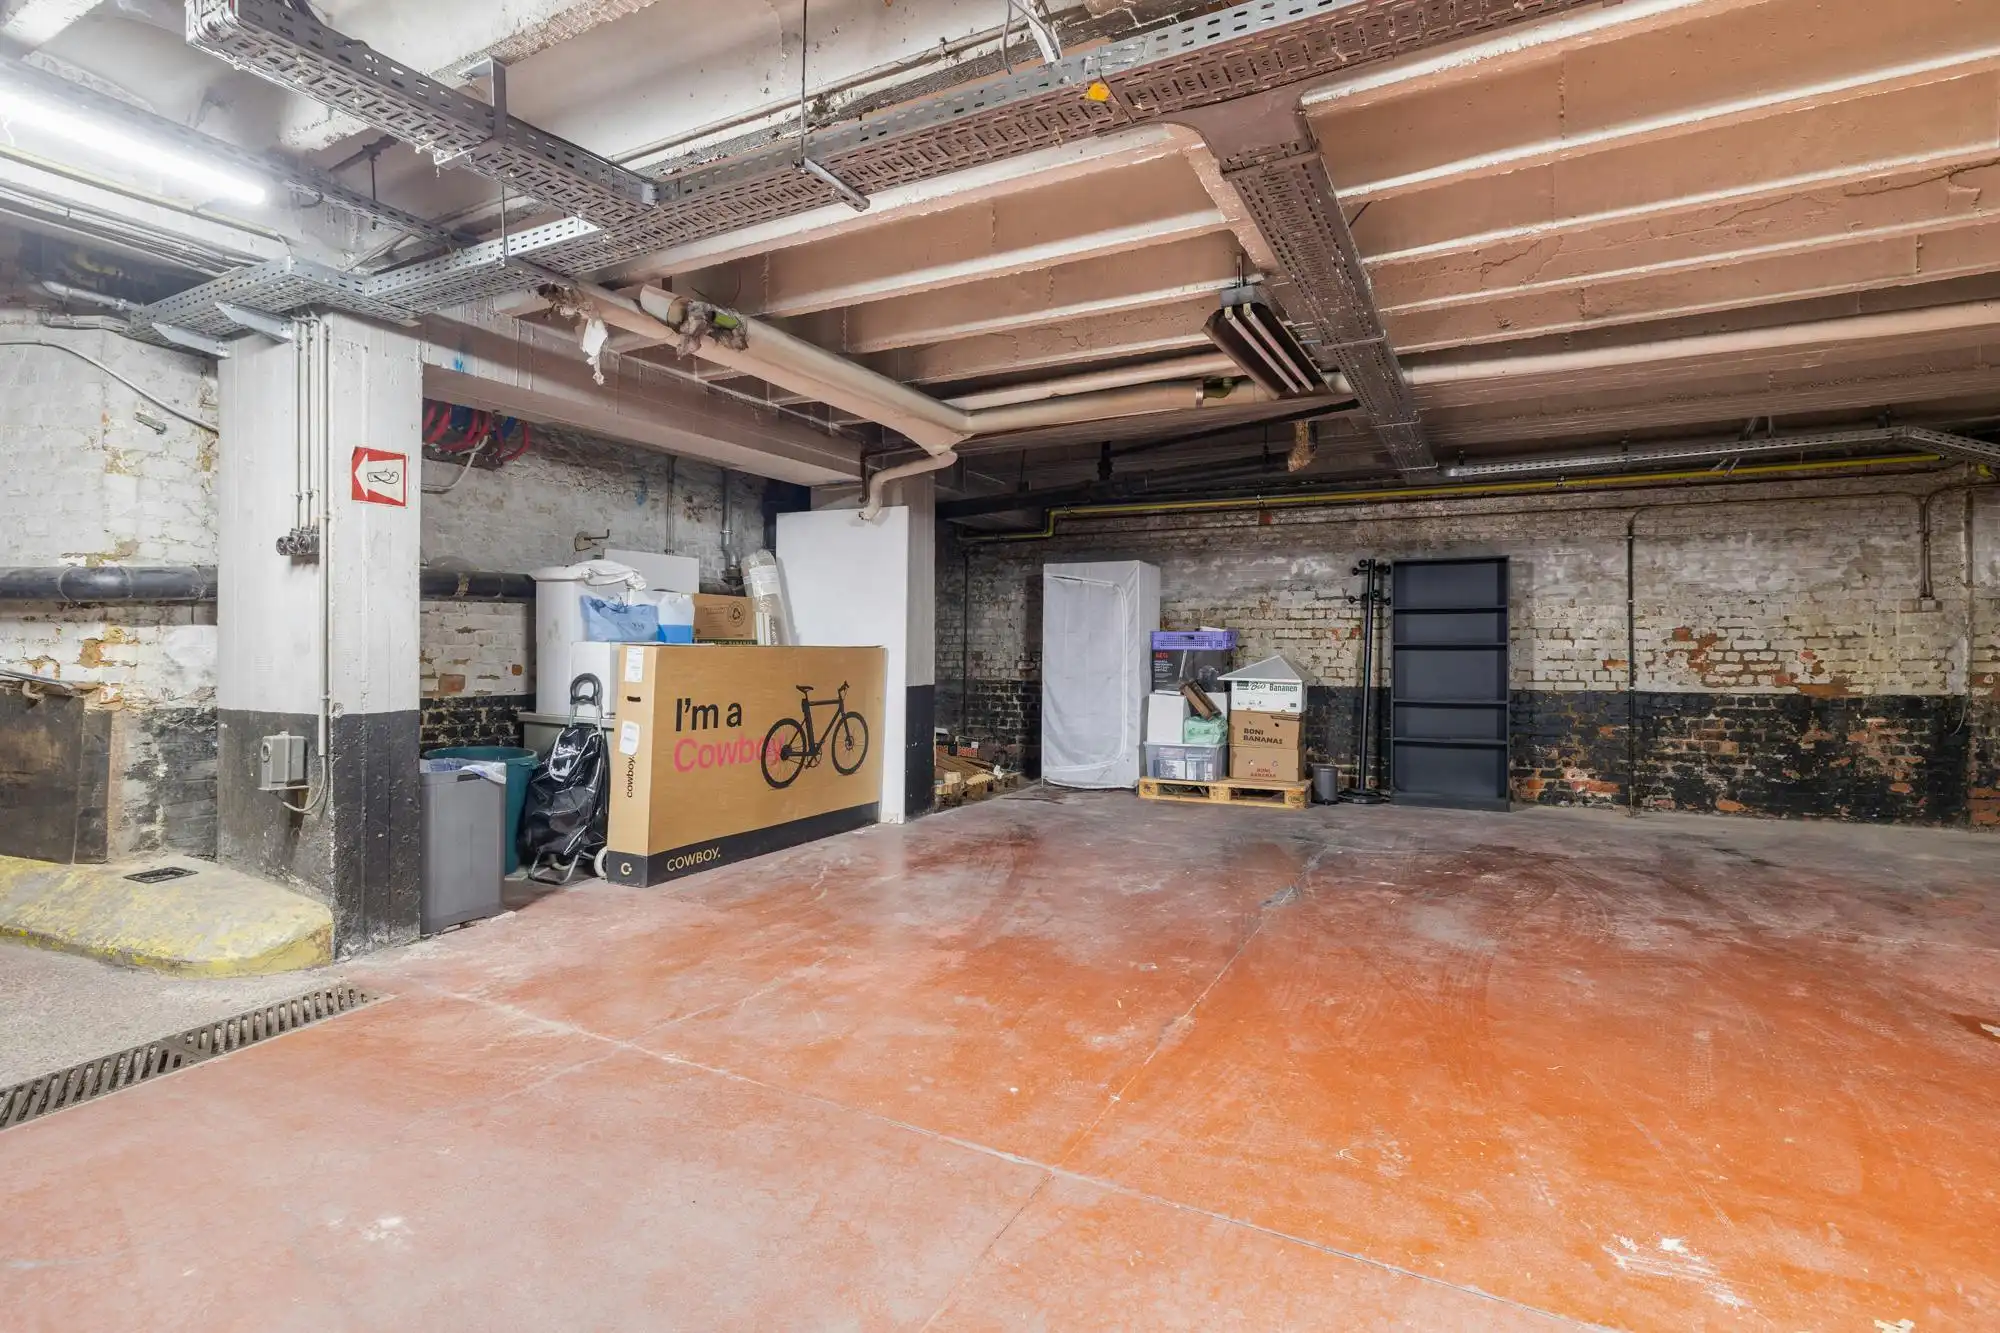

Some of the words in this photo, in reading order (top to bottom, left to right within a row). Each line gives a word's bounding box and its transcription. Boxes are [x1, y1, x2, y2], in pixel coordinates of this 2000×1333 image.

[1250, 681, 1266, 691] Bio
[1269, 683, 1298, 692] Bananen
[726, 702, 743, 728] a
[1243, 727, 1264, 735] BONI
[1243, 735, 1283, 744] BANANAS
[666, 847, 721, 872] COWBOY.
